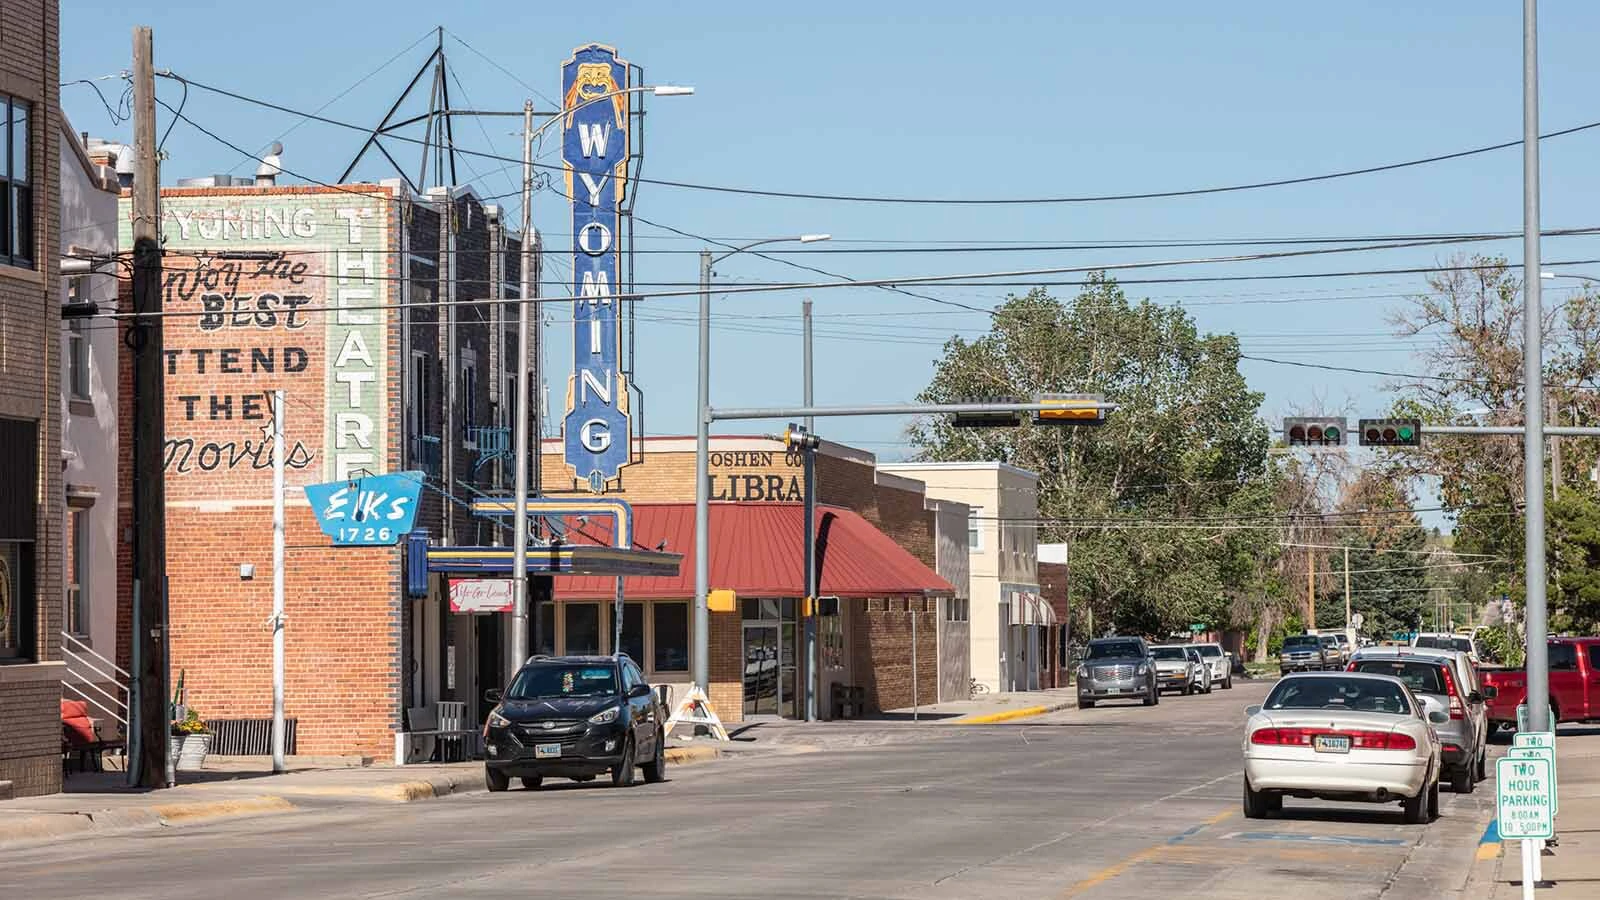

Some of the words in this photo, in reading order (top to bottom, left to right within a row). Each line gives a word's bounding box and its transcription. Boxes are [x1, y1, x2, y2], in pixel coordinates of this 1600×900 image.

[163, 207, 318, 240] YOMING
[163, 262, 243, 302] njoy
[578, 122, 613, 453] WYOMING
[198, 293, 314, 332] BEST
[334, 207, 375, 481] THEATRE
[163, 347, 309, 375] TTEND
[178, 394, 264, 421] THE
[708, 451, 774, 468] OSHEN
[784, 451, 804, 468] CO
[707, 474, 803, 502] LIBRA
[339, 527, 391, 542] 1726
[1525, 736, 1543, 746] TWO
[1512, 763, 1536, 776] TWO
[1508, 780, 1540, 792] HOUR
[1502, 795, 1548, 807] PARKING
[1504, 822, 1513, 832] TO
